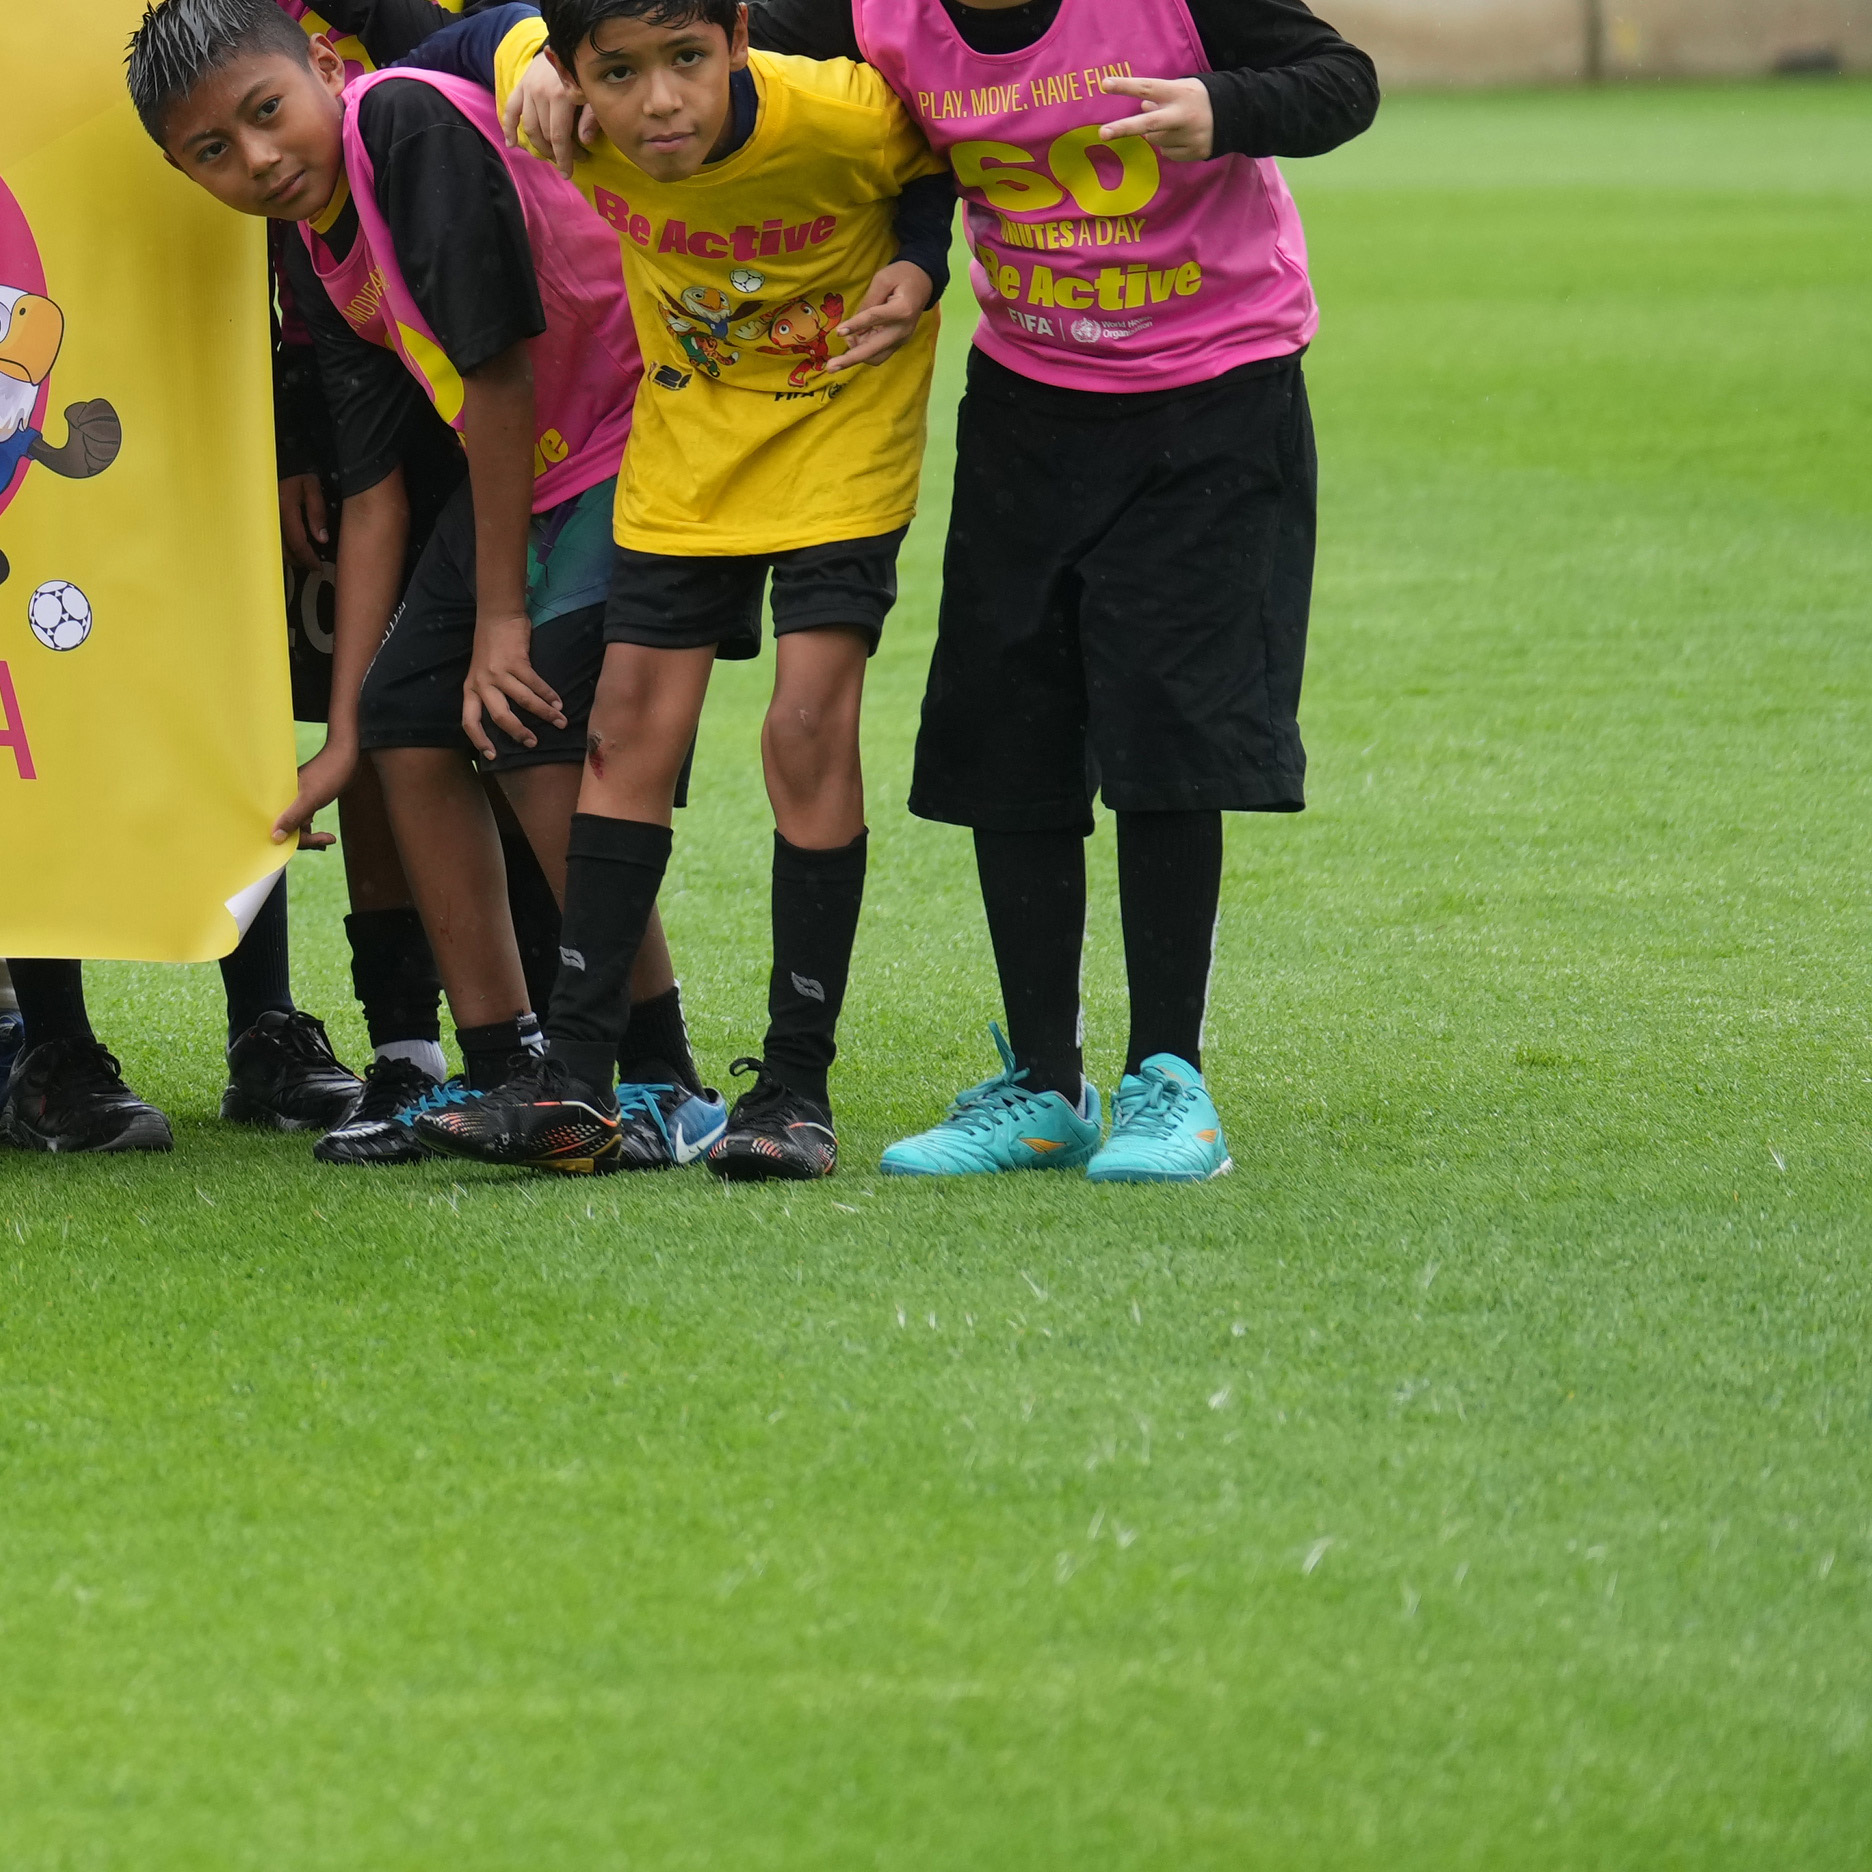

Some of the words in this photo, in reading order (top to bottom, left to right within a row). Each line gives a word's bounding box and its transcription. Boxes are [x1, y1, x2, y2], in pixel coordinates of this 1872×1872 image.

[918, 90, 967, 120] PLAY.
[970, 83, 1029, 116] MOVE.
[1031, 72, 1083, 108] HAVE
[950, 124, 1160, 217] 60
[593, 184, 651, 247] Be
[657, 214, 837, 262] Active
[1078, 219, 1092, 247] A
[1095, 216, 1147, 246] DAY
[976, 243, 1021, 300] Be
[1027, 261, 1202, 311] Active
[1008, 307, 1054, 338] FIFA
